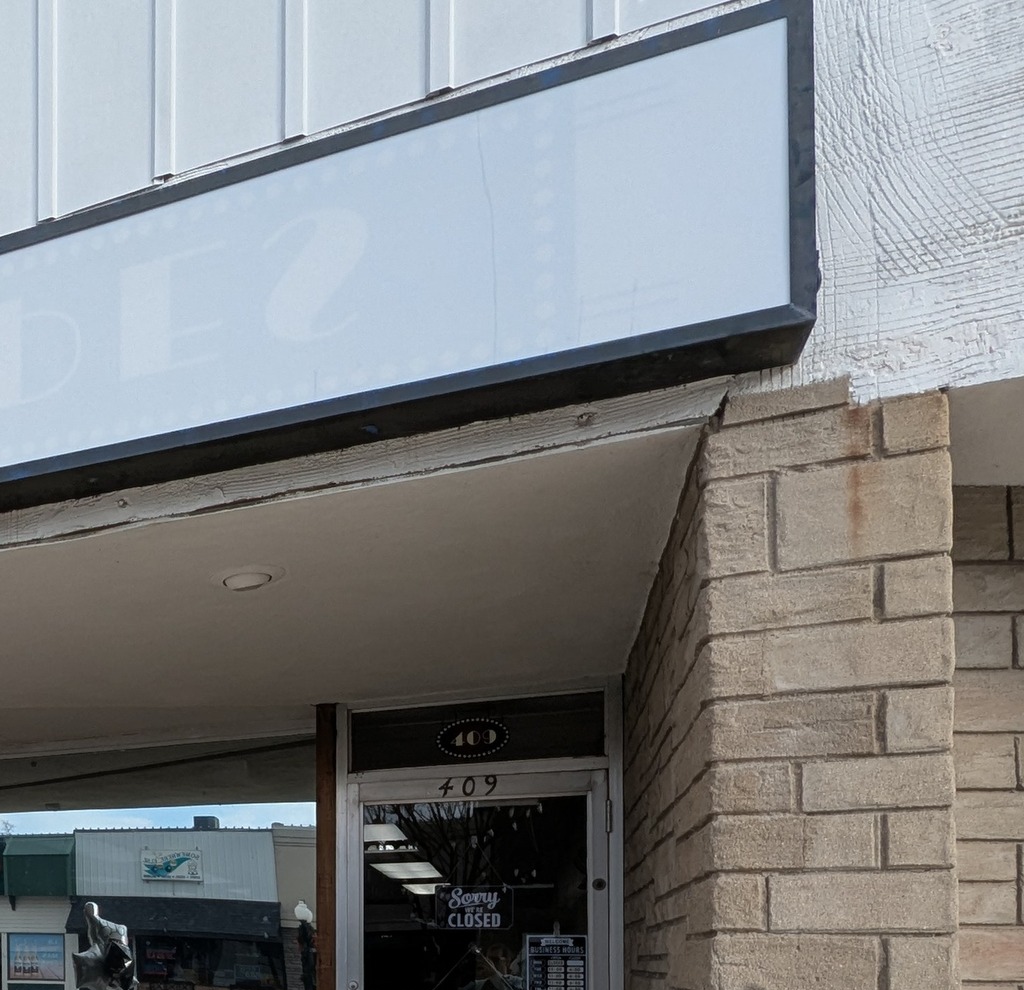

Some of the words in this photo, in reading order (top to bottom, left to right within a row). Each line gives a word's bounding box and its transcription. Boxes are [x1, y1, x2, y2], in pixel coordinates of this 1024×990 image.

[450, 729, 497, 747] 409
[438, 774, 498, 798] 409
[448, 887, 501, 910] Sorry
[447, 912, 501, 928] CLOSED
[530, 946, 561, 954] BUSINESS
[562, 946, 584, 954] HOURS
